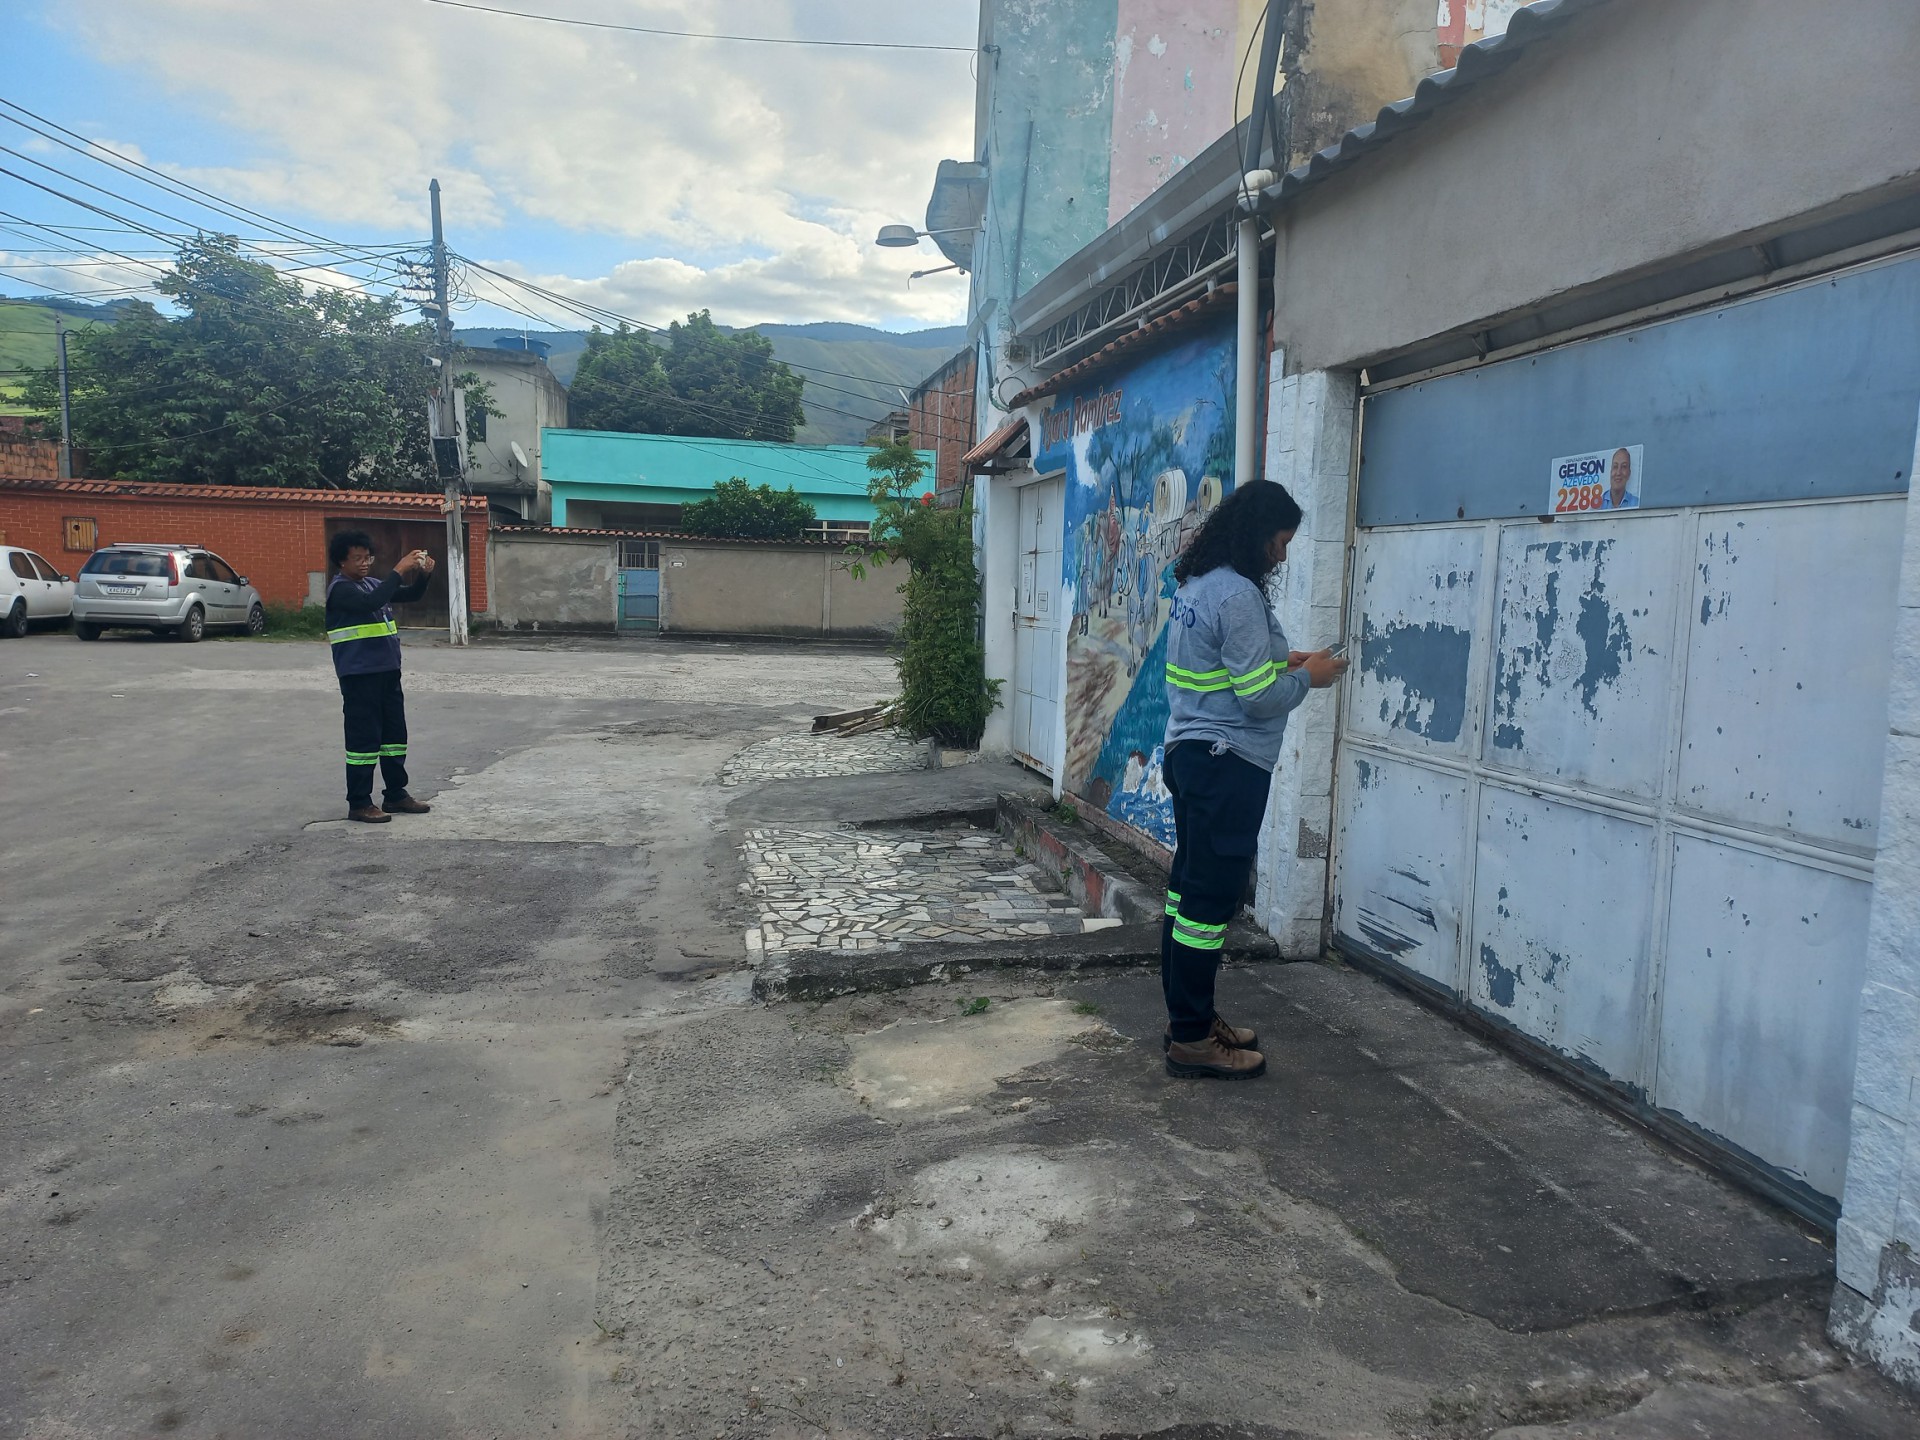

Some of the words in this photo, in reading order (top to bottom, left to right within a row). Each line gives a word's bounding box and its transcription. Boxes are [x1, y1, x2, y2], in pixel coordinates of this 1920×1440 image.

[1072, 386, 1123, 437] Ramirez
[1559, 459, 1606, 479] GELSON
[1562, 474, 1600, 488] AZEVEDO
[1555, 484, 1603, 513] 2288
